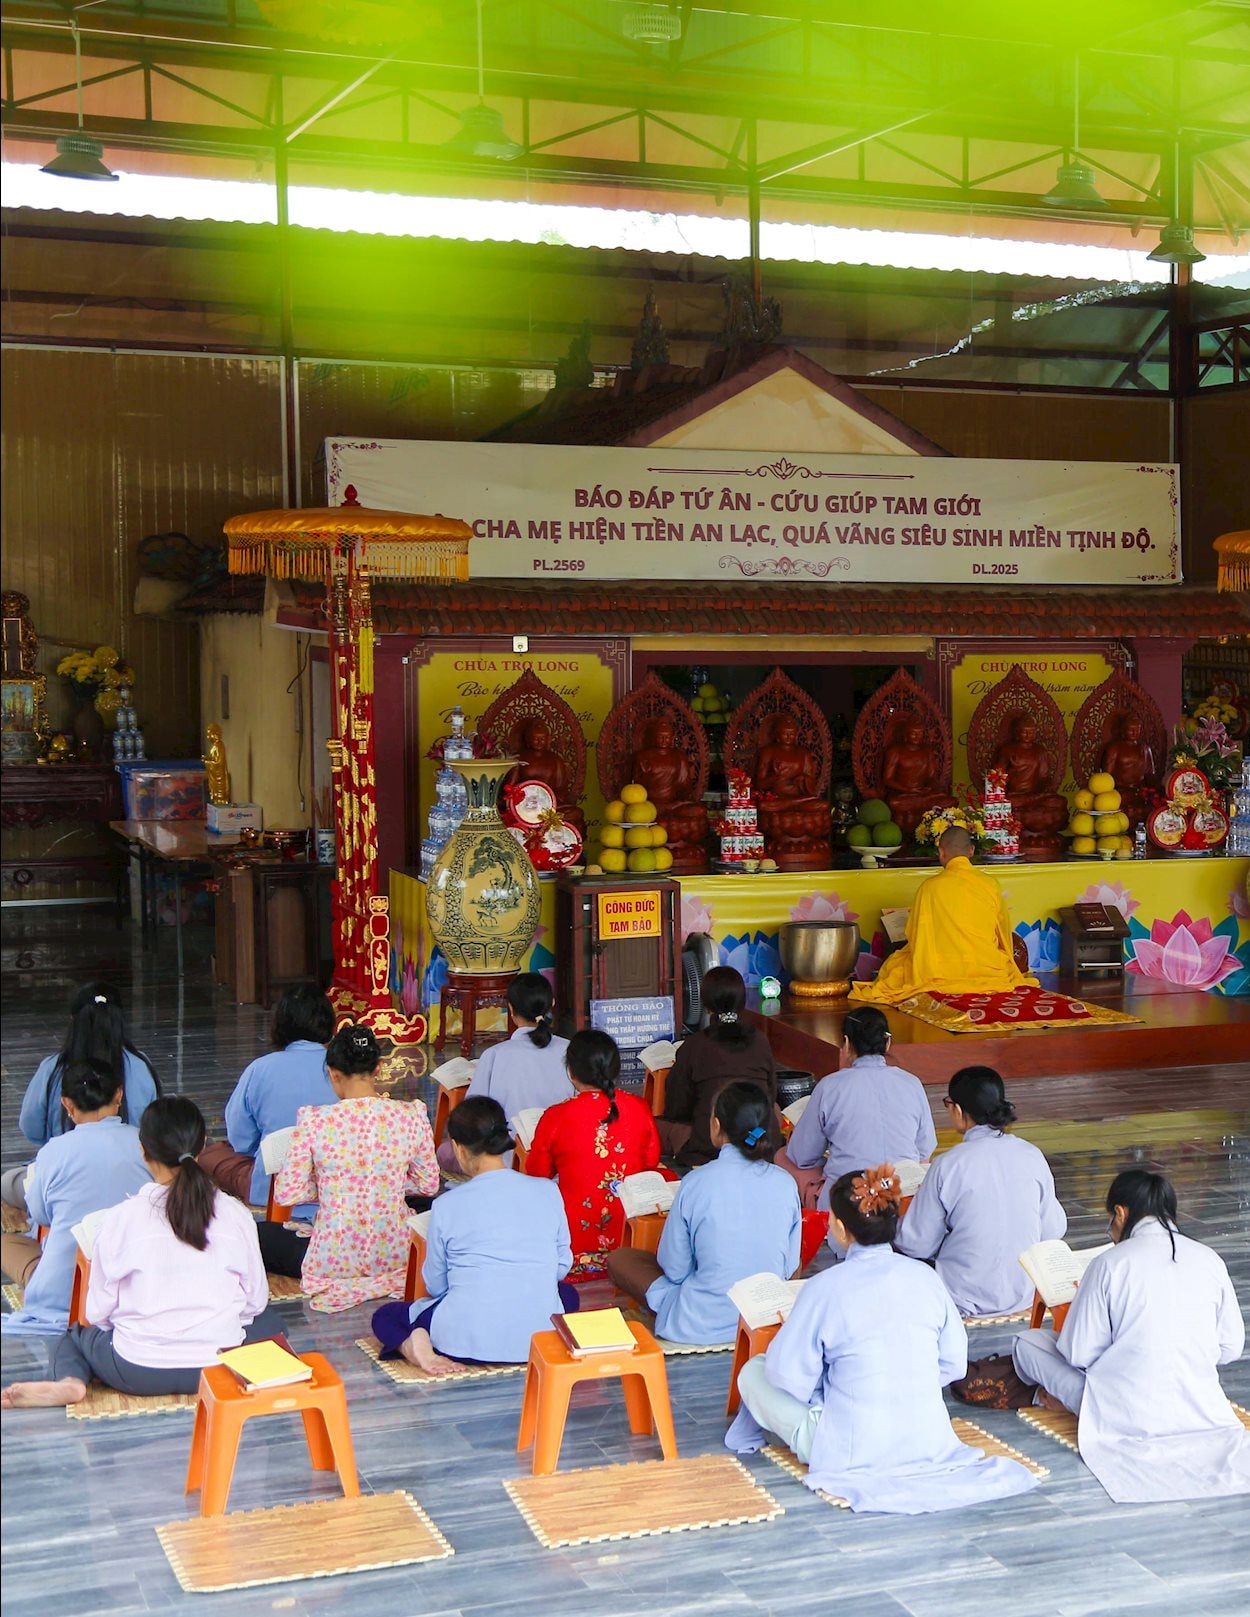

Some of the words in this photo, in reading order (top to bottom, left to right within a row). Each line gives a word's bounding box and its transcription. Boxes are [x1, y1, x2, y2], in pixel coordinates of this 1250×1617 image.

[575, 485, 622, 508] BÁO
[629, 486, 674, 509] ĐÁP
[681, 487, 713, 510] TỨ
[719, 487, 751, 511] ÂN
[771, 493, 818, 513] CỨU
[825, 491, 877, 515] GIÚP
[883, 498, 928, 515] TAM
[934, 494, 980, 516] GIỚI
[472, 519, 521, 539] CHA
[528, 521, 561, 545] MẸ
[569, 517, 626, 545] HIỆN
[632, 516, 684, 542] TIỀN
[690, 523, 726, 541] AN
[731, 524, 776, 546] LẠC,
[782, 521, 830, 547] QUÁ
[835, 525, 895, 546] VÃNG
[901, 524, 947, 547] SIÊU
[953, 529, 1002, 548] SINH
[1009, 524, 1061, 548] MIỀN
[1067, 530, 1115, 552] TỊNH
[1121, 527, 1156, 553] ĐỘ.
[533, 559, 585, 572] PL.2569
[972, 563, 1018, 576] DL.2025
[454, 658, 497, 672] CHÙA
[538, 660, 579, 672] LONG
[1052, 661, 1087, 672] LONG
[606, 900, 632, 914] CÔNG
[635, 898, 655, 912] ĐỨC
[609, 921, 629, 933] TAM
[632, 916, 652, 932] BẢO
[602, 1002, 639, 1012] THÔNG
